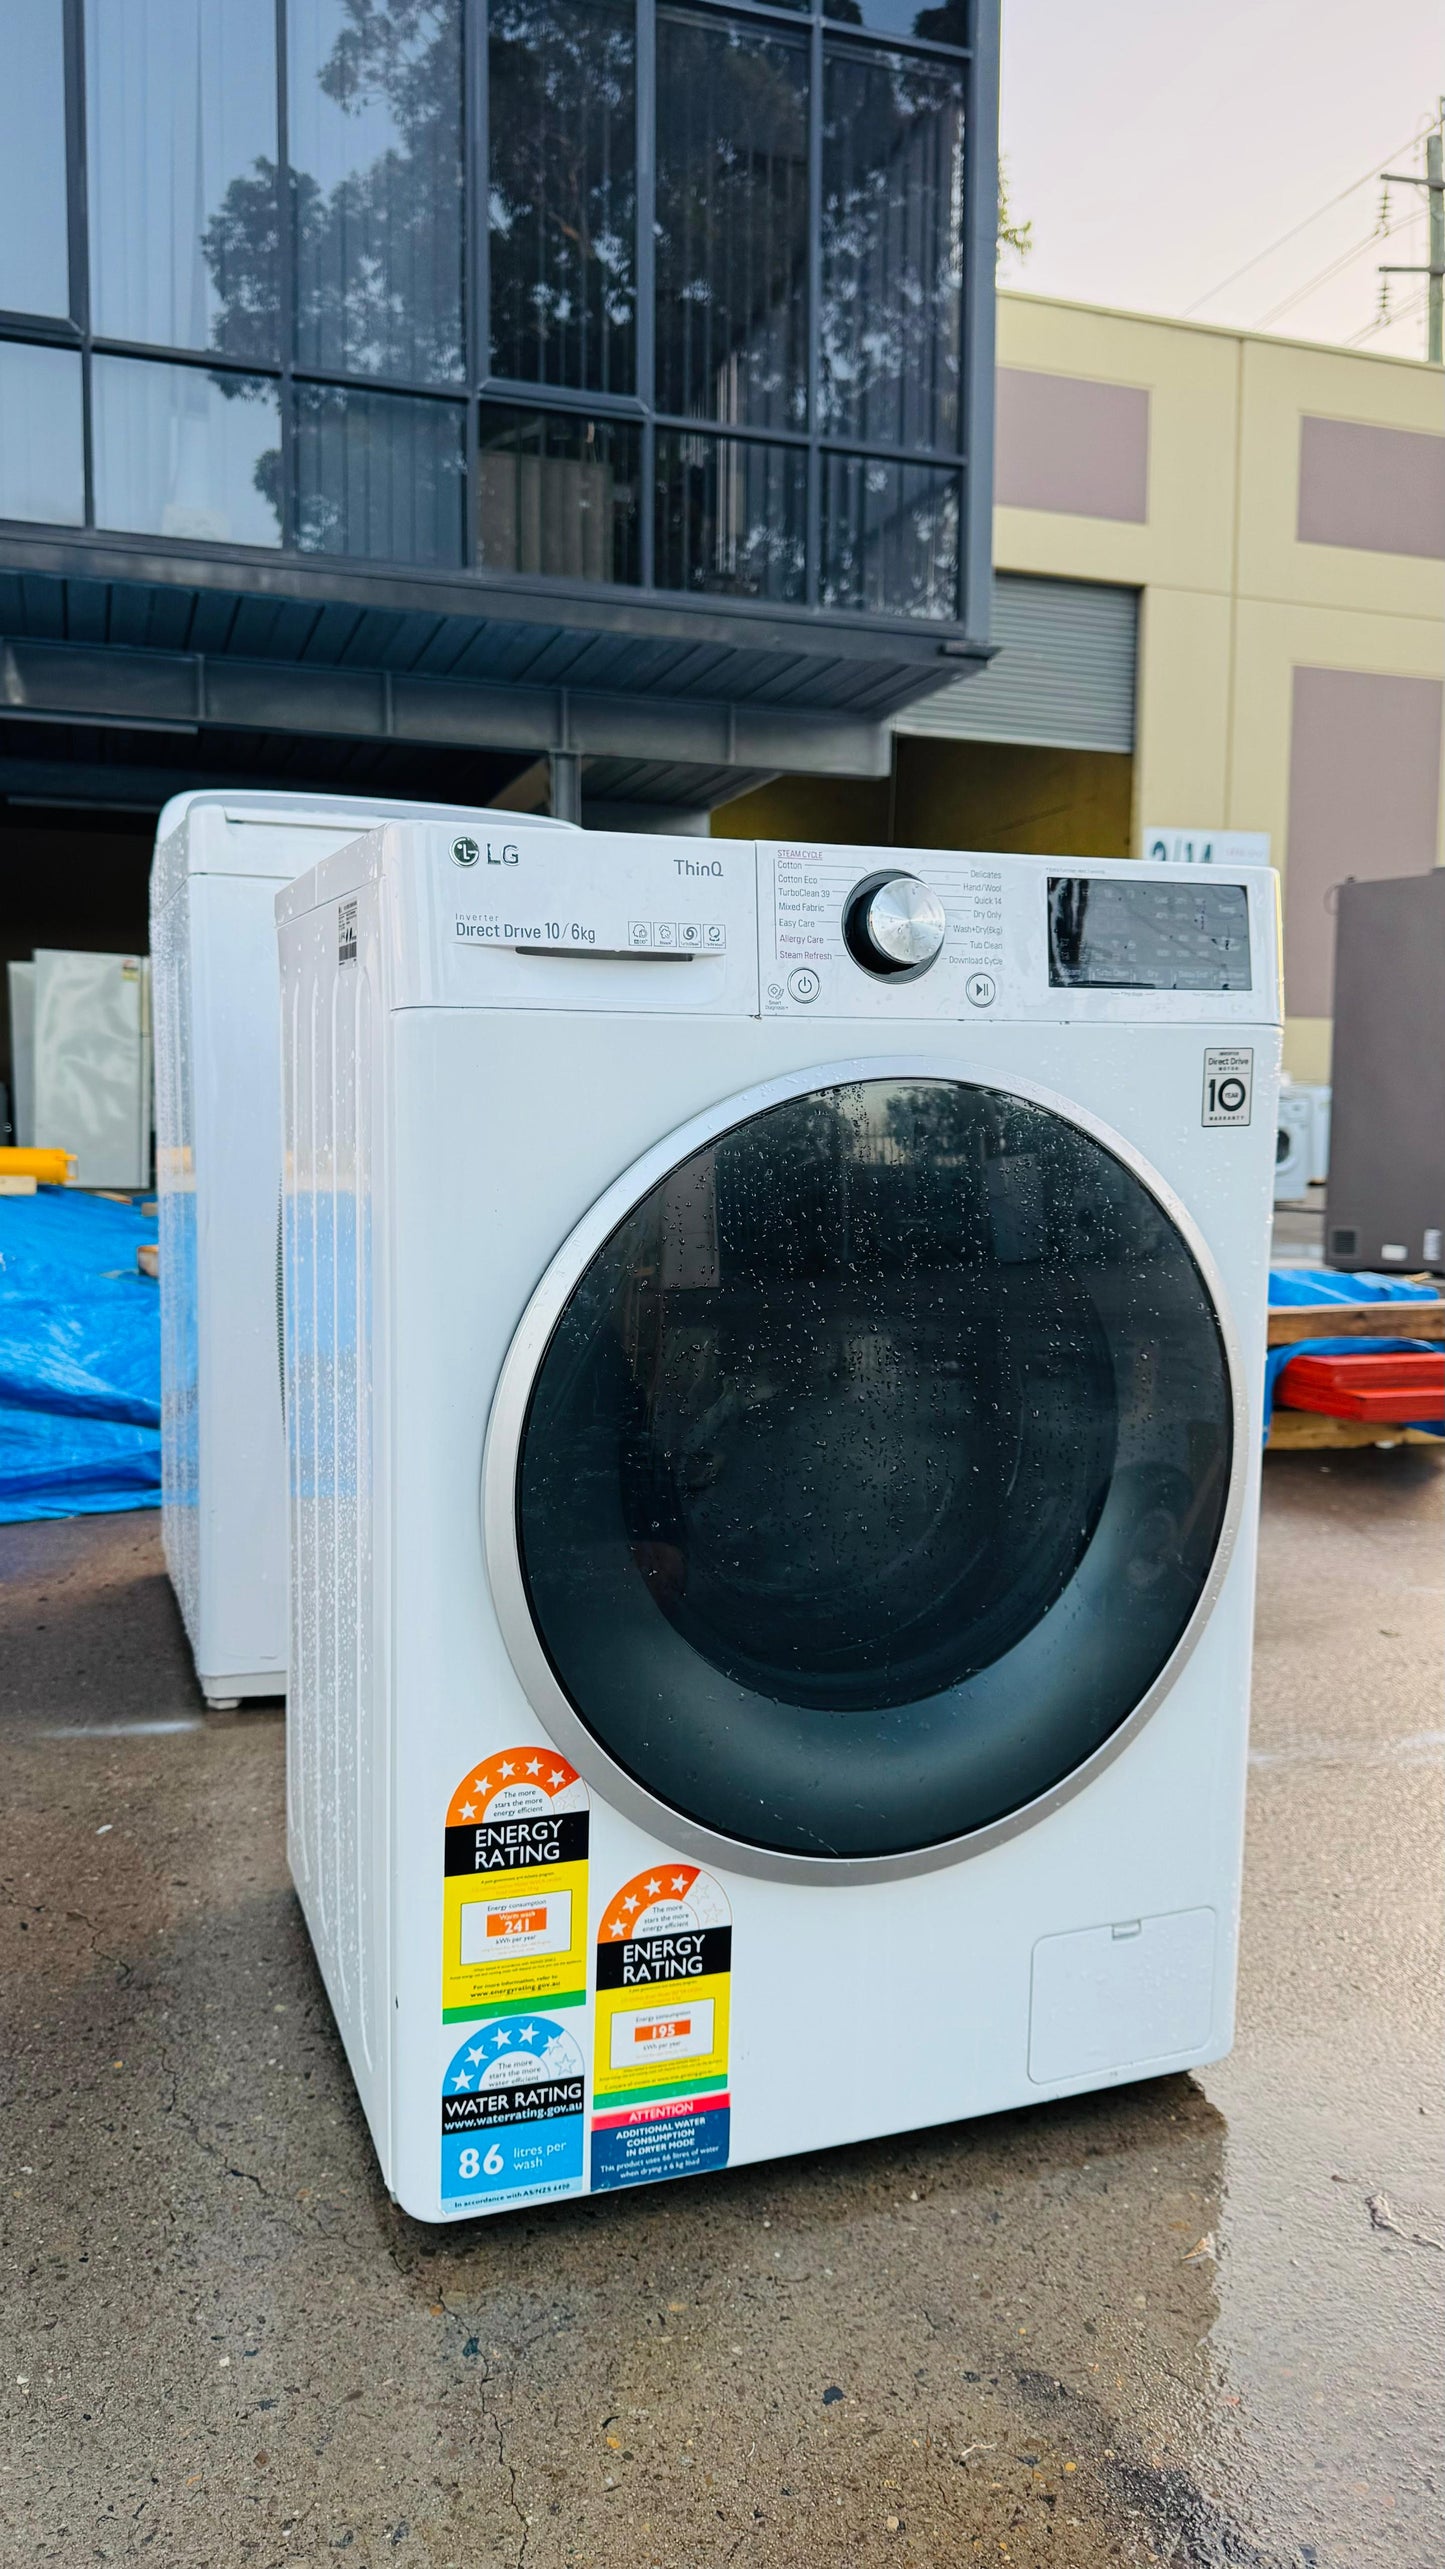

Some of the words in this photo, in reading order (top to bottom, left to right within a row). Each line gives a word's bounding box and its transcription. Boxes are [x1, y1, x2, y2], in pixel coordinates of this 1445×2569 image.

[487, 843, 520, 865] LG
[777, 849, 801, 858] STEAM
[802, 850, 822, 859] CYCLE
[673, 859, 724, 877] ThinQ
[777, 860, 803, 869] Cotton
[778, 873, 803, 883] Cotton
[804, 875, 818, 884] Eco
[970, 869, 1001, 879] Delicates
[778, 887, 820, 897] TurboClean
[821, 889, 830, 898] 39
[974, 895, 993, 905] Quick
[779, 902, 801, 911] Mixed
[802, 903, 825, 912] Fabric
[455, 912, 500, 922] Inverter
[973, 909, 986, 919] Dry
[987, 910, 1002, 921] Only
[779, 918, 797, 928] Easy
[798, 919, 815, 928] Care
[456, 922, 501, 938] Direct
[504, 923, 541, 939] Drive
[780, 934, 806, 944] Allergy
[806, 935, 824, 944] Care
[970, 940, 983, 949] Tub
[984, 941, 1003, 950] Clean
[780, 950, 803, 959] Steam
[804, 951, 833, 960] Refresh
[949, 955, 983, 965] Download
[984, 956, 1003, 967] Cycle
[1208, 1057, 1229, 1066] Direct
[1230, 1057, 1249, 1066] Drive
[1208, 1078, 1246, 1112] 10
[503, 1791, 516, 1799] The
[519, 1789, 537, 1797] more
[494, 1801, 510, 1809] stars
[512, 1799, 523, 1807] the
[493, 1809, 515, 1817] energy
[517, 1806, 543, 1815] efficient
[475, 1819, 563, 1848] ENERGY
[475, 1842, 560, 1870] RATING
[487, 1903, 507, 1912] Energy
[509, 1899, 547, 1910] consumption
[652, 1906, 665, 1914] The
[666, 1904, 683, 1912] more
[499, 1912, 519, 1921] Warm
[660, 1914, 671, 1922] the
[505, 1918, 530, 1935] 241
[642, 1924, 663, 1933] energy
[664, 1921, 688, 1929] efficient
[495, 1937, 511, 1945] kWh
[512, 1936, 522, 1944] per
[523, 1934, 536, 1942] year
[623, 1934, 706, 1964] ENERGY
[623, 1955, 703, 1985] RATING
[651, 2023, 676, 2040] 195
[513, 2060, 533, 2068] more
[489, 2072, 506, 2080] stars
[521, 2067, 541, 2075] more
[511, 2075, 539, 2084] efficient
[446, 2094, 509, 2117] WATER
[515, 2083, 582, 2107] RATING
[444, 2102, 583, 2131] www.waterrating.gov.au
[629, 2101, 694, 2122] ATTENTION
[616, 2123, 673, 2140] ADDITIONAL
[674, 2117, 706, 2130] WATER
[626, 2128, 695, 2148] CONSUMPTION
[626, 2149, 636, 2158] IN
[638, 2144, 666, 2155] DRYER
[668, 2138, 695, 2151] MODE
[458, 2143, 504, 2180] 86
[513, 2146, 543, 2159] litres
[546, 2142, 567, 2156] per
[513, 2157, 543, 2171] wash
[600, 2164, 615, 2173] This
[616, 2159, 644, 2172] product
[645, 2157, 660, 2166] uses
[691, 2148, 699, 2157] of
[700, 2145, 719, 2154] water
[620, 2170, 639, 2179] when
[640, 2165, 662, 2176] drying
[669, 2162, 674, 2170] 6
[676, 2160, 684, 2169] kg
[685, 2157, 700, 2166] load
[463, 2195, 504, 2207] accordance
[506, 2192, 521, 2200] with
